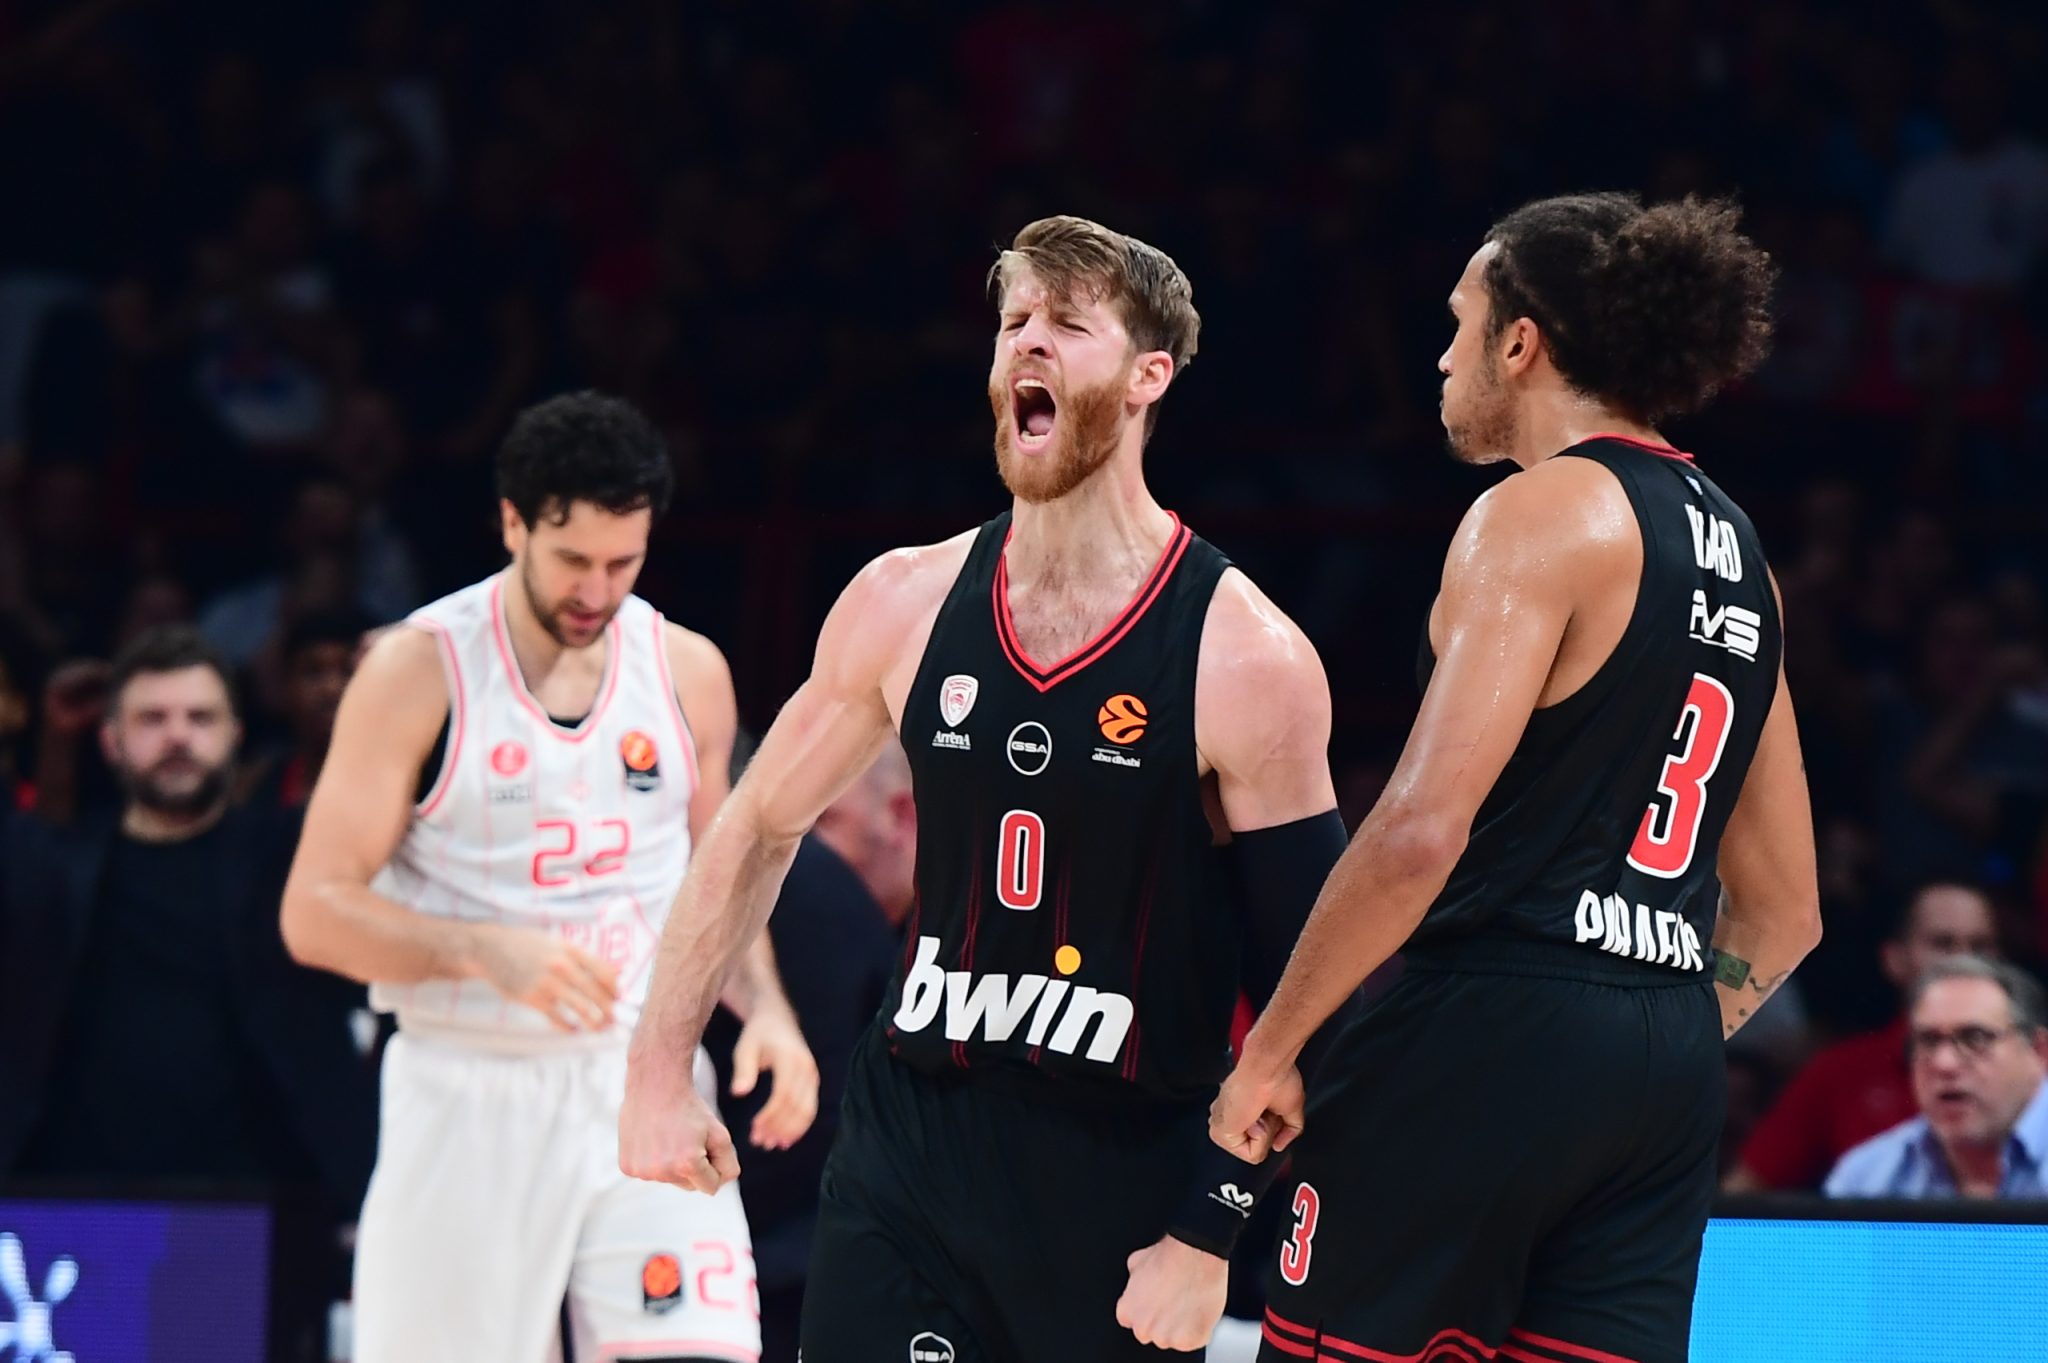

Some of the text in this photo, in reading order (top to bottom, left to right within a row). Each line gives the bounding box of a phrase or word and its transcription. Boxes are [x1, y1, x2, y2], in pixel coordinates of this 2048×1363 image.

[1011, 740, 1048, 754] GSA
[1625, 672, 1735, 879] 3
[531, 819, 631, 887] 22
[997, 809, 1045, 911] 0
[893, 935, 1134, 1063] bwin
[1279, 1181, 1320, 1286] 3
